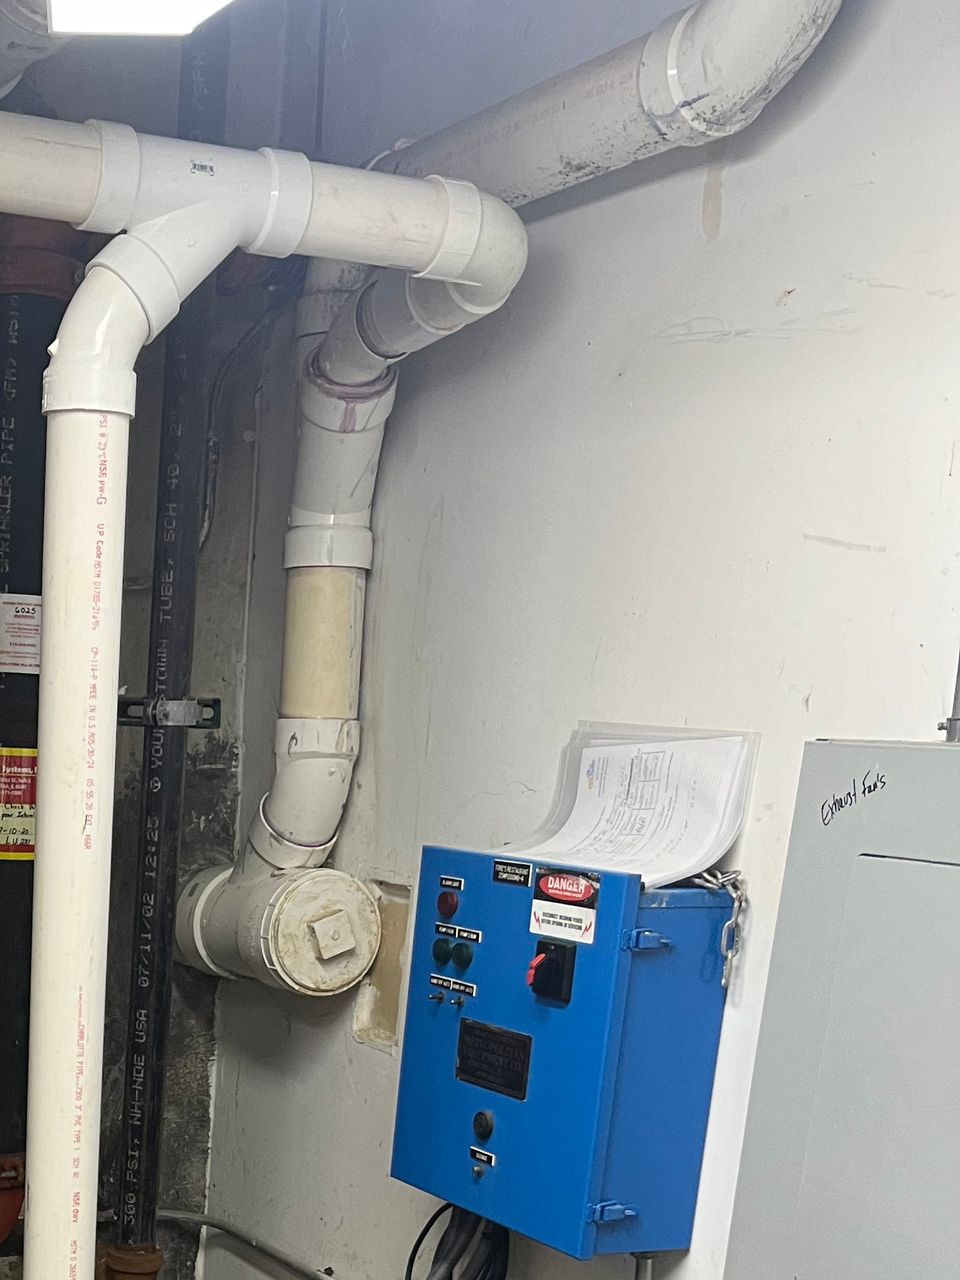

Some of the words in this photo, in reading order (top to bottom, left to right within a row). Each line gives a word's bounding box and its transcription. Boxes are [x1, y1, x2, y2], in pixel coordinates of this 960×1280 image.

[0, 416, 15, 464] PIPE
[96, 523, 105, 537] UP
[163, 503, 177, 542] SCH
[95, 540, 104, 559] Code
[93, 560, 102, 578] ASTM
[15, 606, 37, 615] 6025
[89, 683, 98, 700] MADE
[88, 704, 97, 713] IN
[144, 816, 159, 878] 12:25
[547, 876, 586, 893] DANGER
[137, 892, 154, 988] 07/11/02
[134, 1009, 148, 1043] USA
[76, 1060, 84, 1076] PIPE
[123, 1192, 136, 1226] 300
